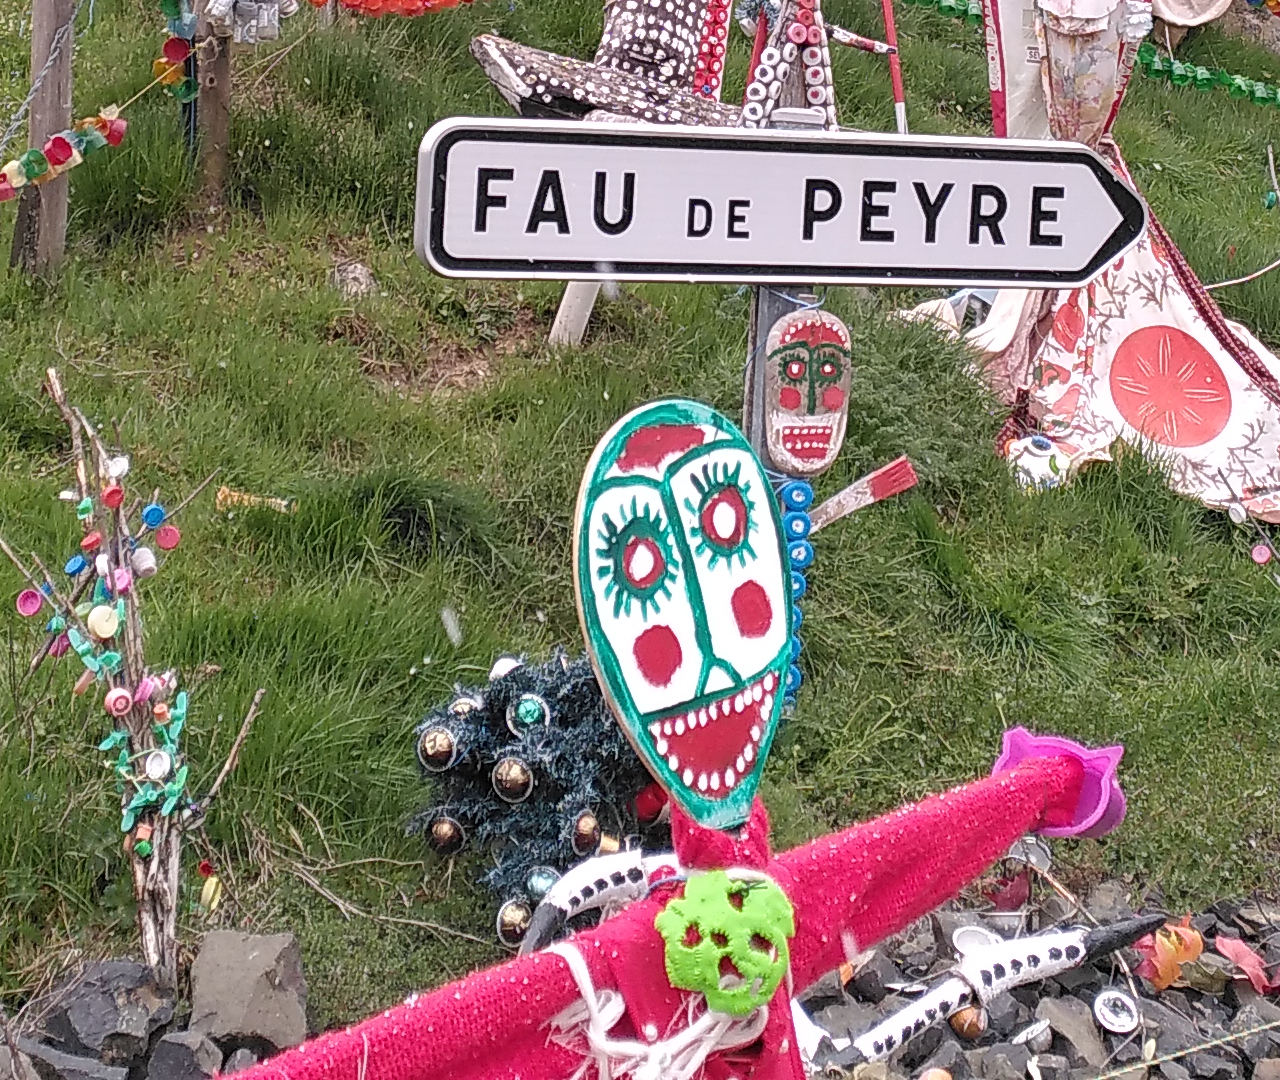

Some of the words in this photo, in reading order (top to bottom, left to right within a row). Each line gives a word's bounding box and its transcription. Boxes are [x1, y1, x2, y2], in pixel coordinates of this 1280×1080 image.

[473, 166, 637, 237] FAU
[687, 197, 752, 240] DE
[800, 177, 1066, 248] PEYRE
